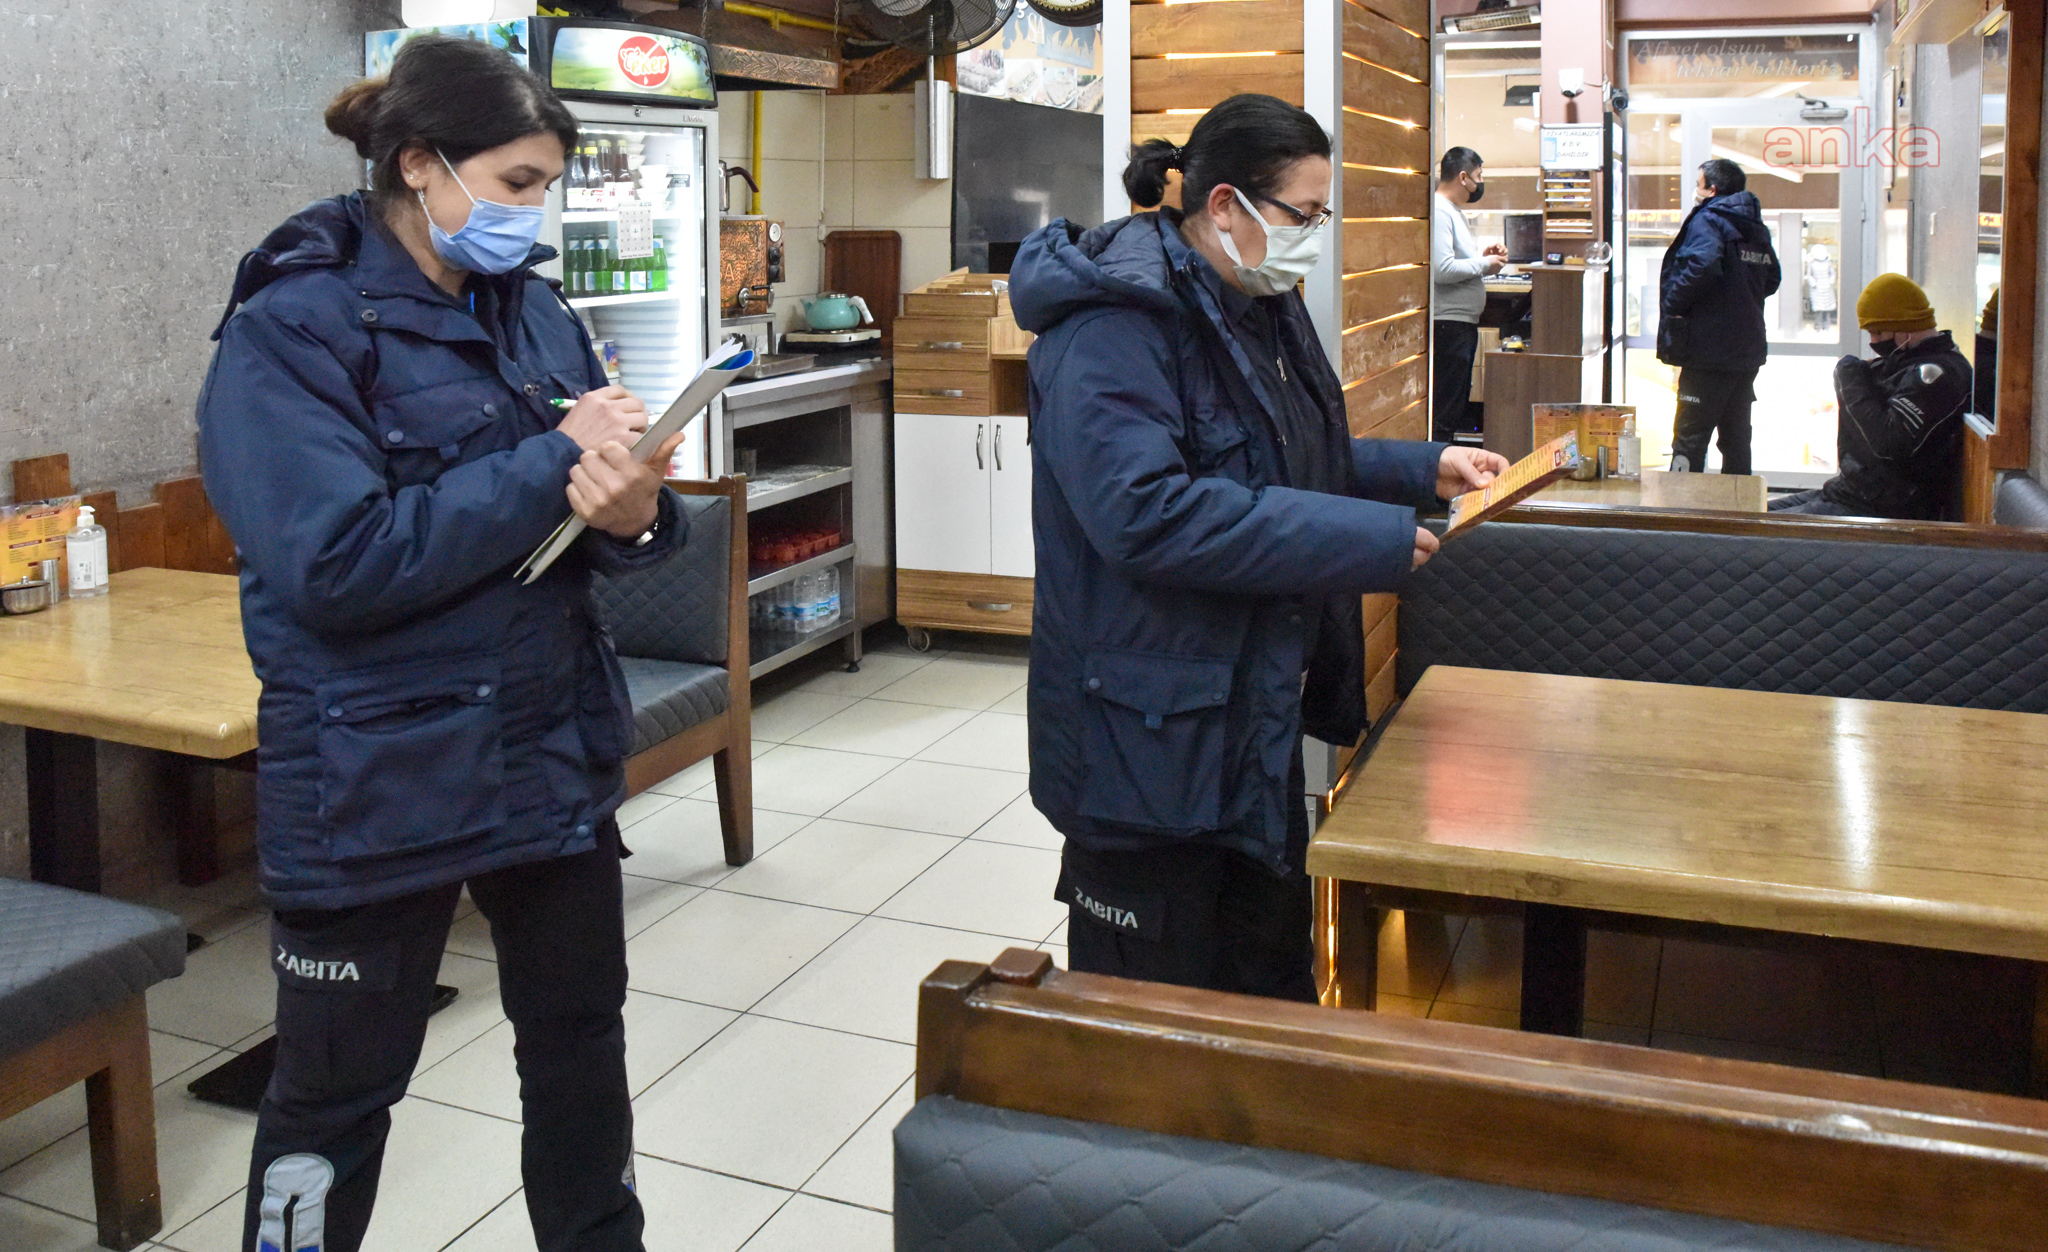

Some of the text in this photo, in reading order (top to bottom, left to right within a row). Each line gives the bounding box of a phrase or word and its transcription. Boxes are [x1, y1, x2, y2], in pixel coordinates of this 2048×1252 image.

[1637, 39, 1773, 61] Afiyet olsun,
[1677, 61, 1744, 77] tekrar
[1741, 249, 1772, 265] ZABITA
[1075, 886, 1138, 929] ZABITA
[277, 944, 360, 981] ZABITA
